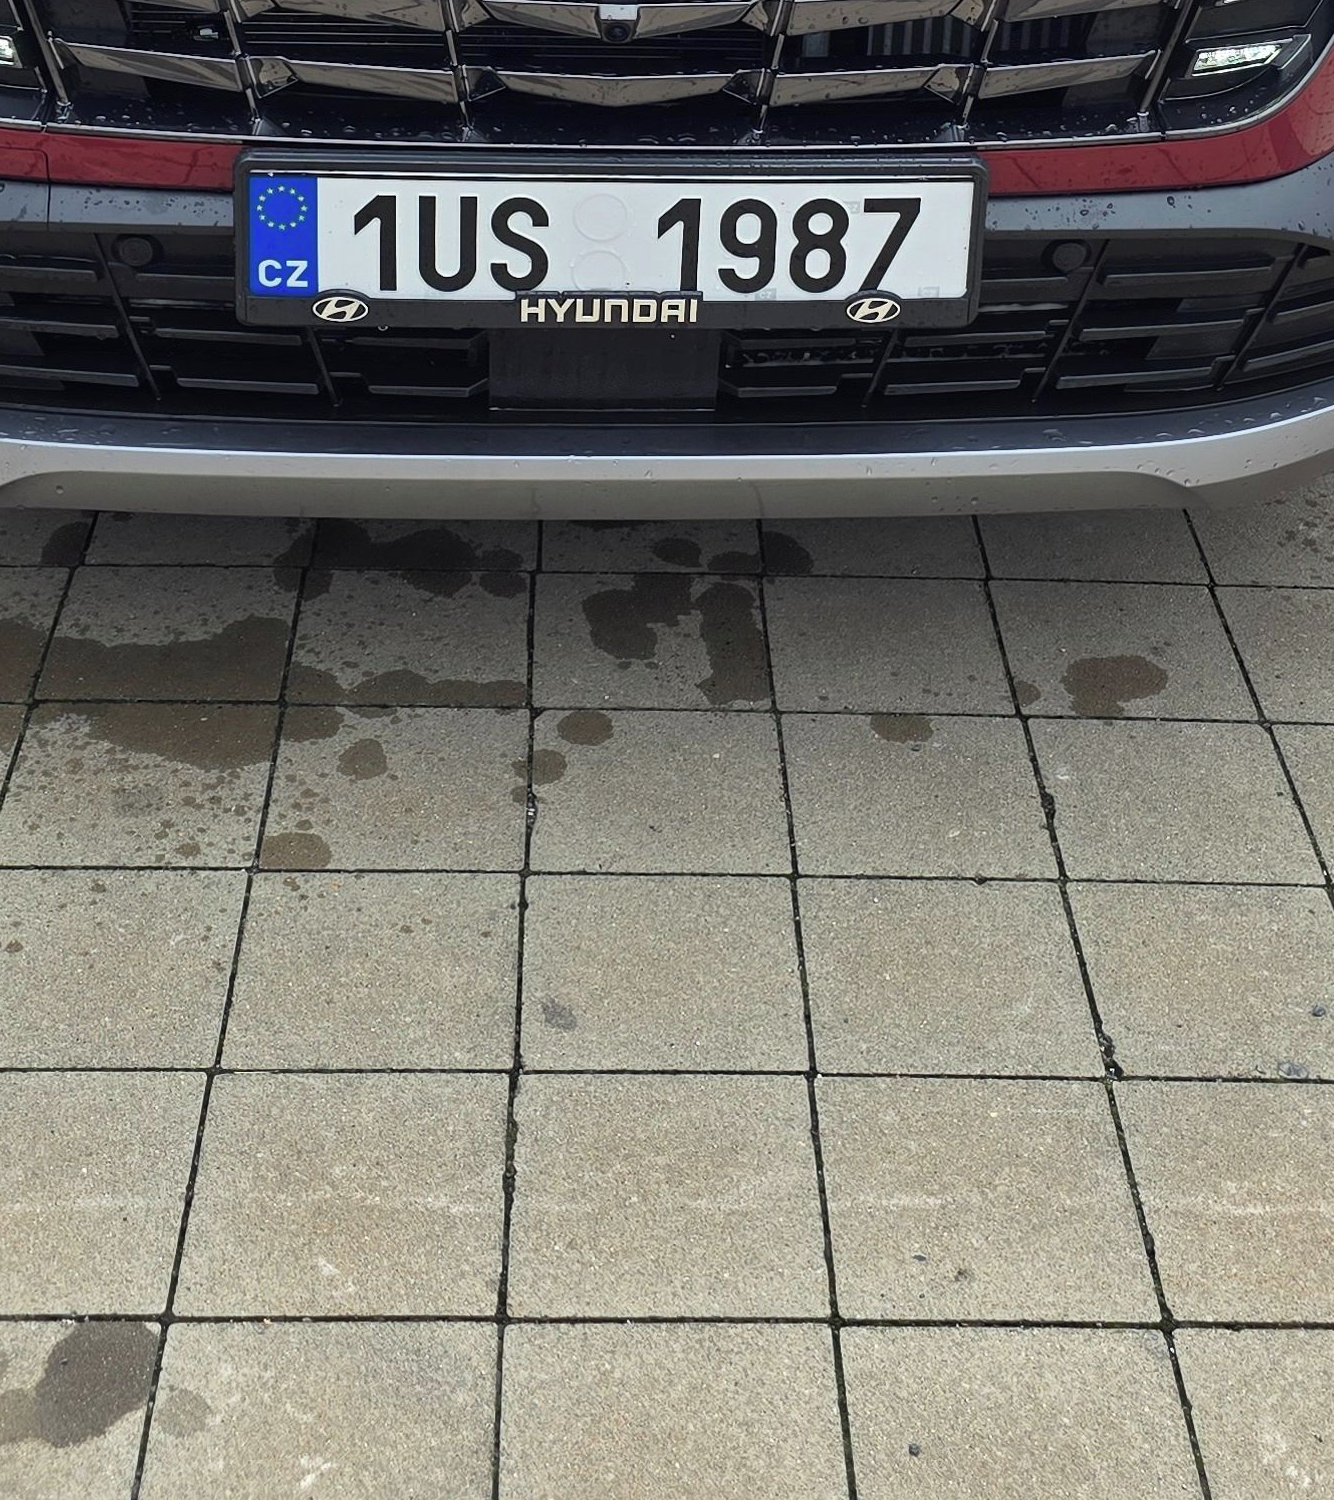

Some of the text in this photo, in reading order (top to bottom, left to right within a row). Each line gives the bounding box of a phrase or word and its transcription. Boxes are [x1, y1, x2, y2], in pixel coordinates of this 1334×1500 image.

[354, 194, 922, 294] 1US 1987
[257, 259, 309, 288] CZ
[520, 298, 699, 323] HYUNDAI
